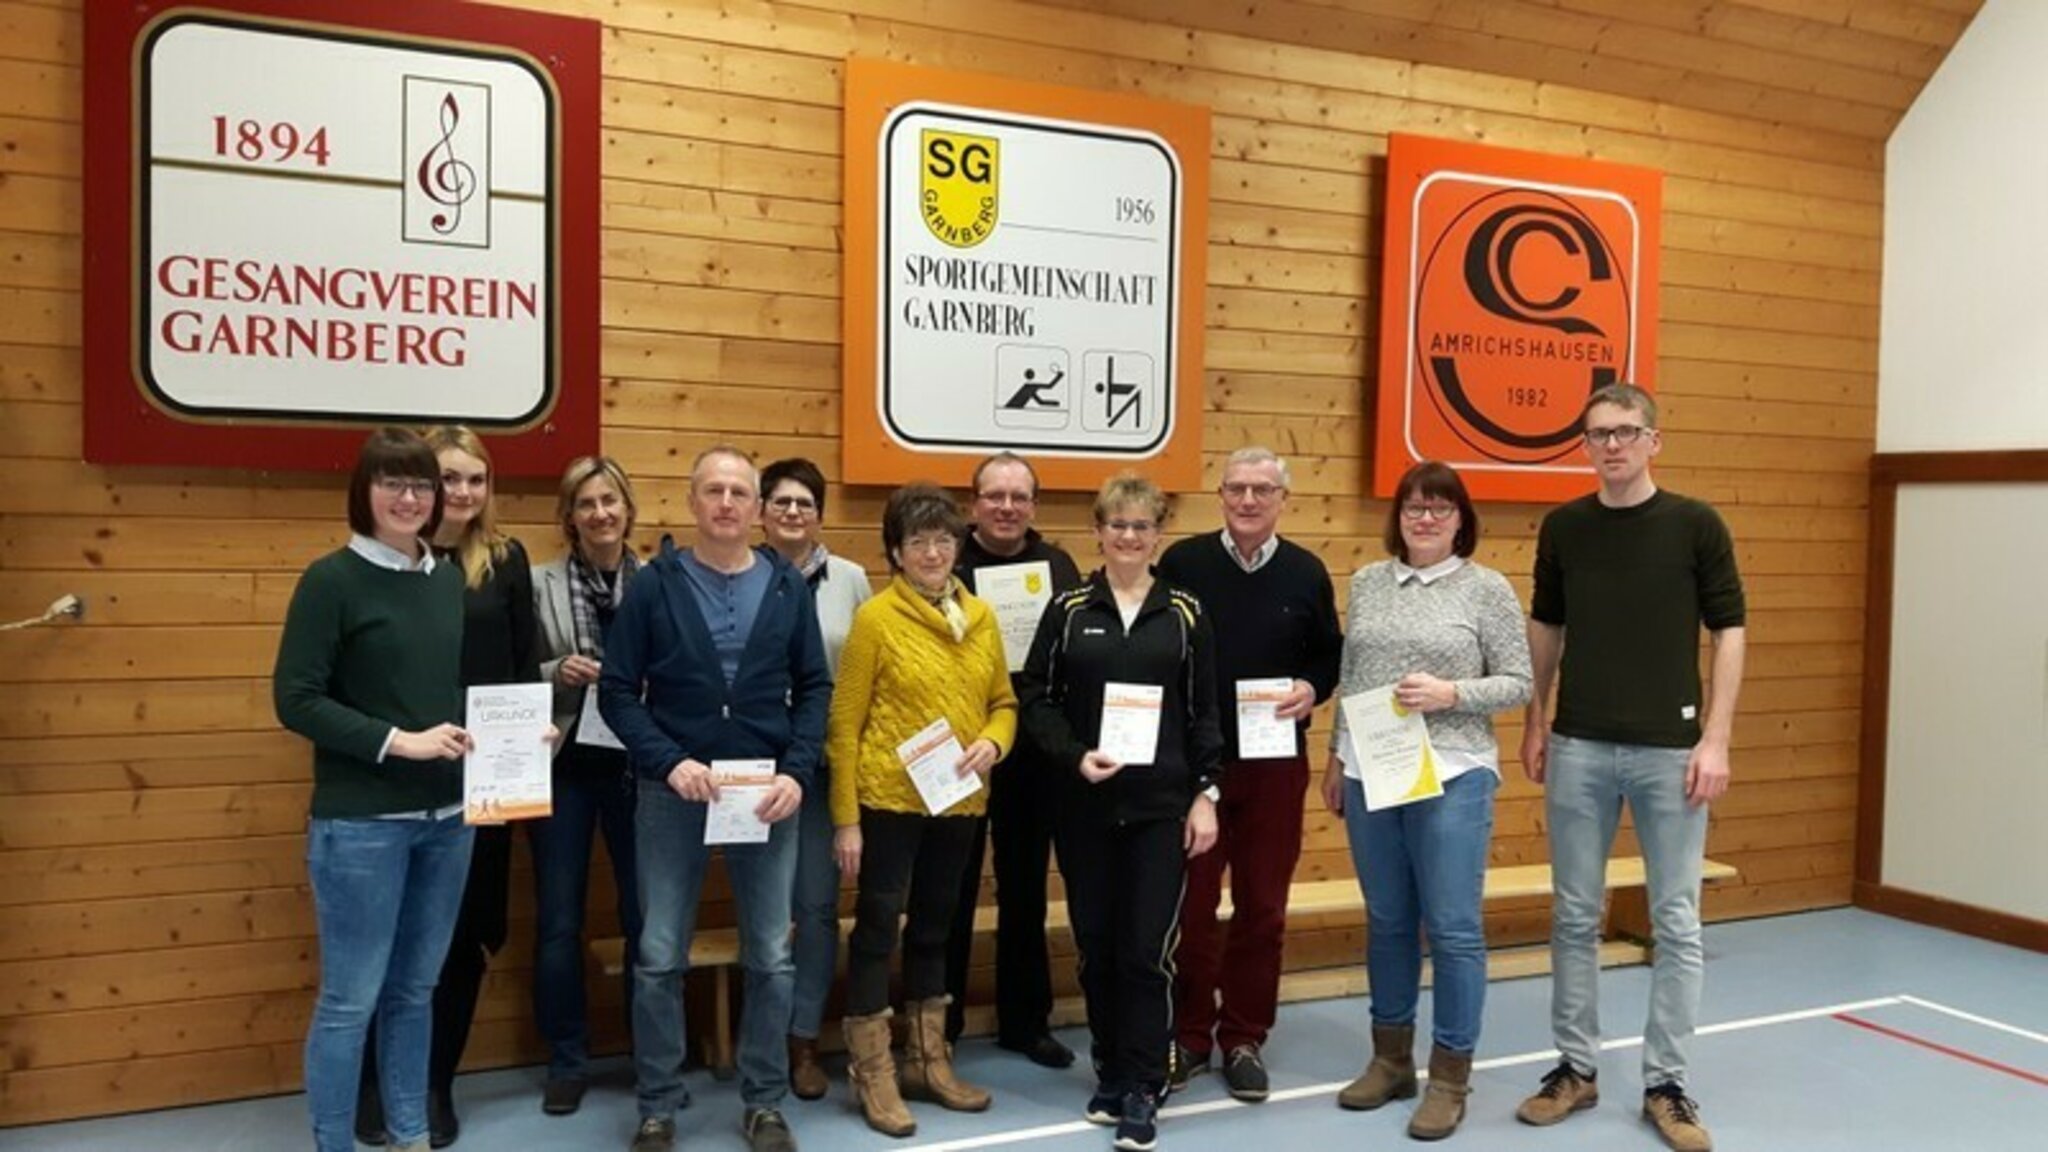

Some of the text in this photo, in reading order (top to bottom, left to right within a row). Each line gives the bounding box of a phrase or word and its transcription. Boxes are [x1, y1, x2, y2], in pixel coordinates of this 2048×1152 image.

[212, 116, 331, 166] 1894
[928, 139, 992, 183] SG
[924, 188, 994, 244] GARNBERG
[1115, 197, 1155, 224] 1956
[158, 255, 537, 319] GESANGVEREIN
[905, 254, 1157, 305] SPORTGEMEINSCHAFT
[161, 310, 465, 367] GARNBERG
[904, 297, 1035, 337] GARNBERG
[1431, 333, 1613, 362] AMRICHSHAUSEN
[1507, 387, 1548, 407] 1982
